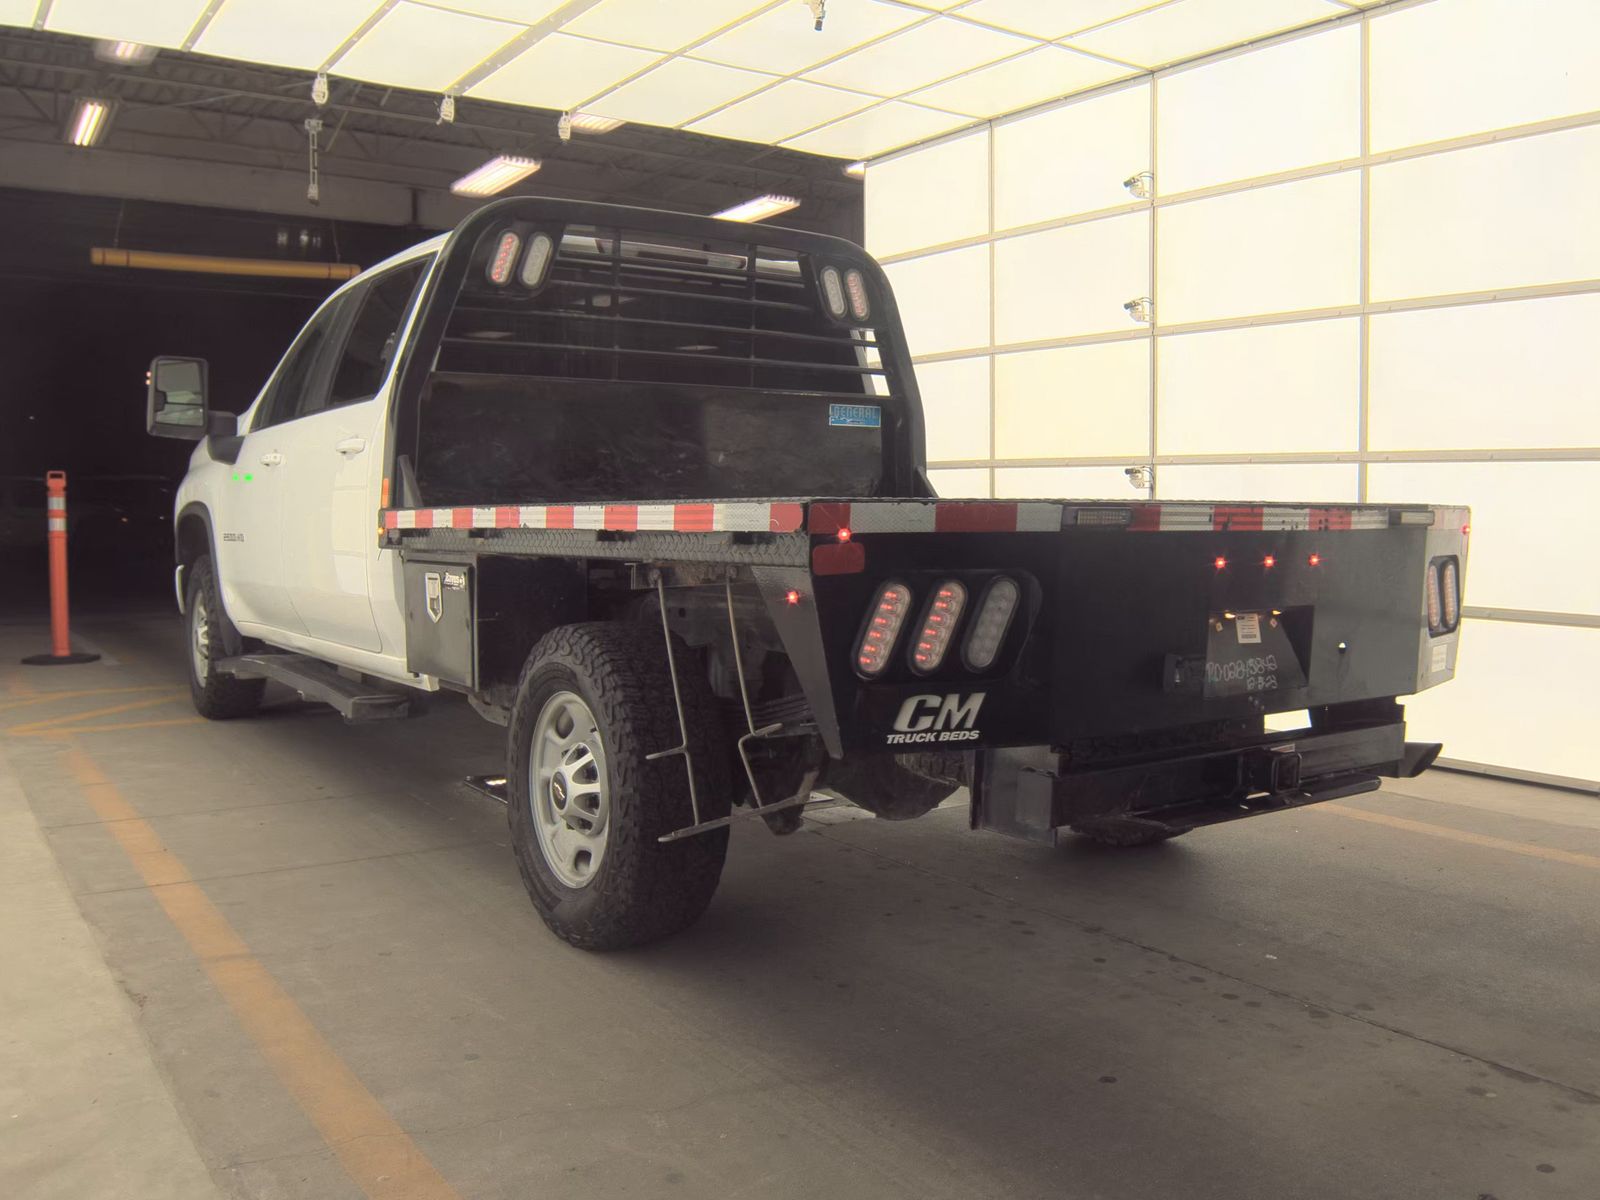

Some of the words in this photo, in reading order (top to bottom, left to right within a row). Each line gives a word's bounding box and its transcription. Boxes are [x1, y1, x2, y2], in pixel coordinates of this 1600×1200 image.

[893, 692, 986, 732] CM
[886, 732, 938, 745] TRUCK
[938, 730, 980, 742] BEDS
